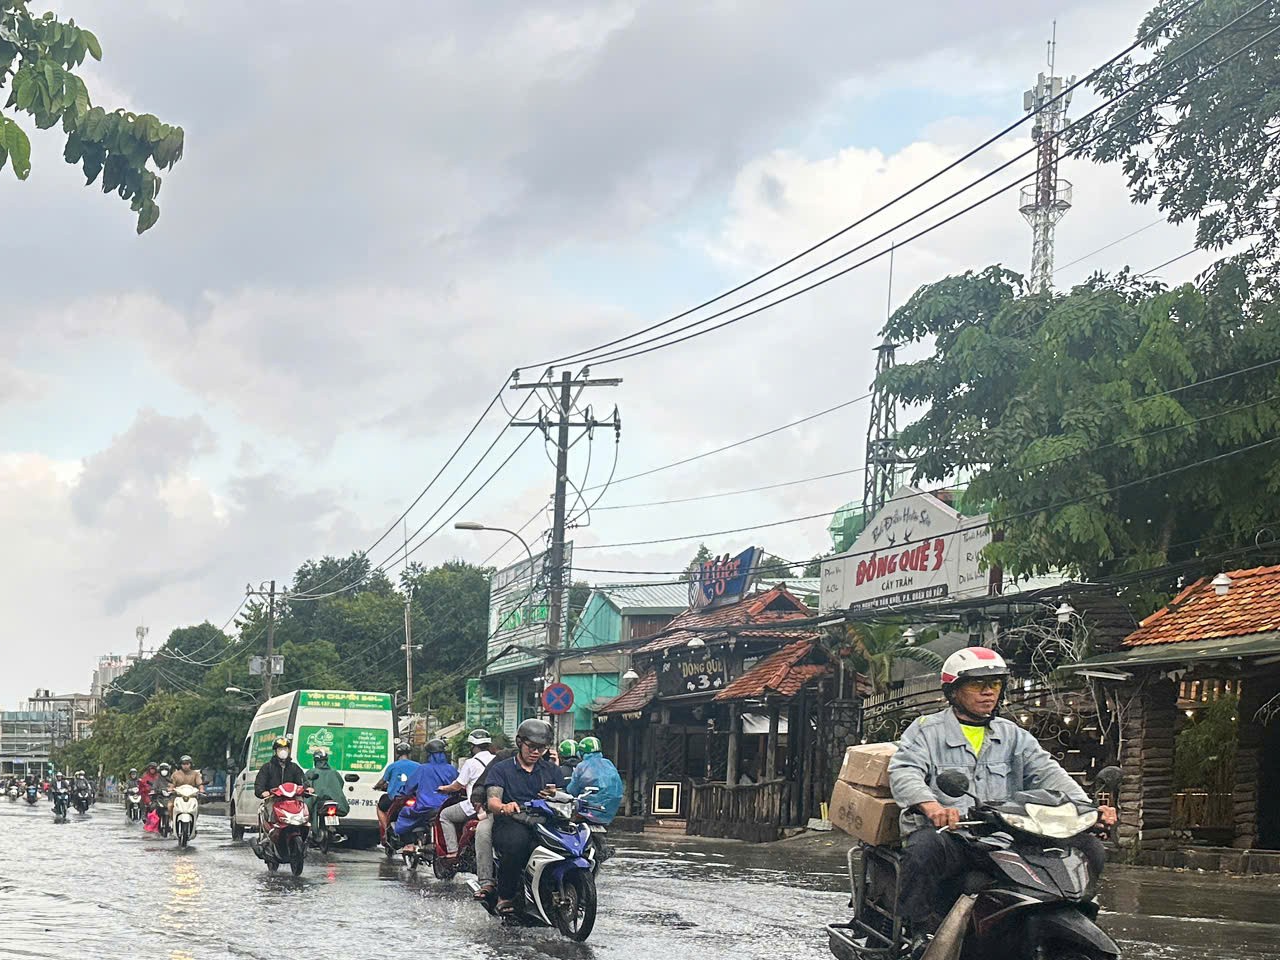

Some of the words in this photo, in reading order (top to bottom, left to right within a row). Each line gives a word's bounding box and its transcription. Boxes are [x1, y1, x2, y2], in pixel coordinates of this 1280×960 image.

[704, 554, 740, 595] Tiger
[856, 552, 899, 586] ĐỒNG
[899, 540, 931, 572] QUÊ
[931, 538, 945, 571] 3
[698, 675, 710, 688] 3
